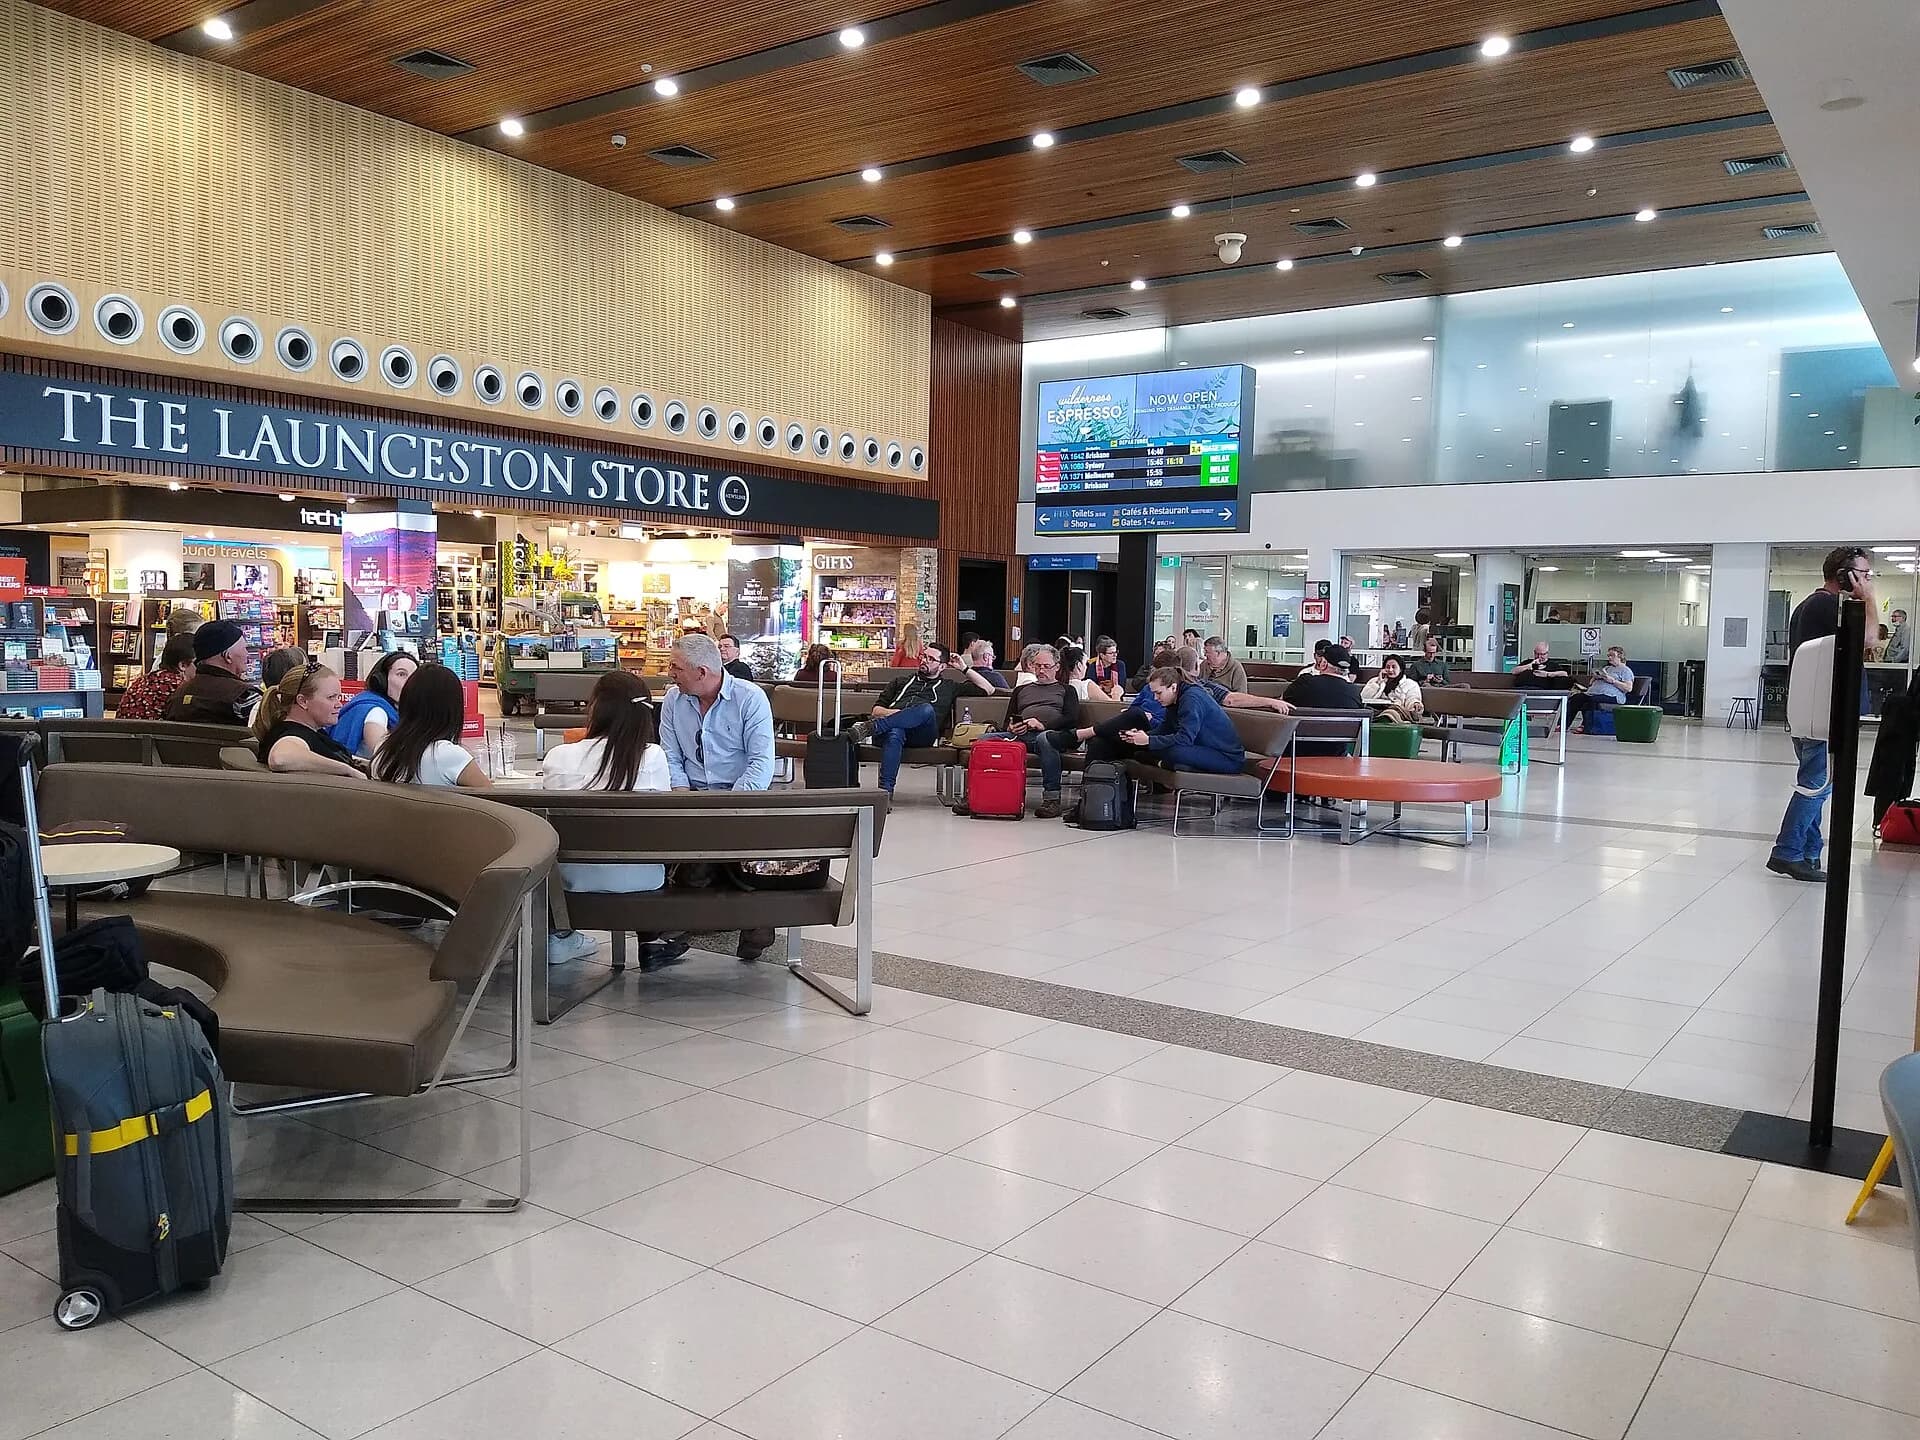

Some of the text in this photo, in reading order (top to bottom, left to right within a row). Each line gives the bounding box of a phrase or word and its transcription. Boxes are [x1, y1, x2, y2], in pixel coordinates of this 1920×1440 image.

[1057, 384, 1113, 406] wilderness
[1149, 390, 1218, 406] NOW OPEN
[1047, 406, 1122, 425] ESPRESSO
[43, 386, 710, 511] THE LAUNCESTON STORE
[1060, 453, 1069, 461] VA
[1085, 451, 1110, 459] Brisbane
[1146, 447, 1164, 455] 14:40
[1060, 463, 1069, 471] VA
[1085, 461, 1105, 471] Sydney
[1146, 458, 1164, 466] 15:45
[1209, 455, 1230, 463] RELAX
[1084, 471, 1115, 480] Melbourne
[1209, 465, 1230, 473] RELAX
[1084, 481, 1109, 490] Brisbane
[1208, 475, 1230, 484] RELAX
[1071, 509, 1095, 518] Toilets
[1121, 506, 1142, 516] Cafés
[1142, 507, 1149, 515] &
[1149, 505, 1190, 515] Restaurant
[1070, 519, 1088, 529] Shop
[1121, 517, 1142, 527] Gates
[1143, 517, 1156, 526] 1-4
[183, 545, 268, 560] ound travels
[813, 554, 854, 570] GIFTS
[924, 555, 932, 594] HEART
[737, 593, 769, 601] Launceston
[743, 587, 764, 596] Best of
[923, 600, 931, 614] OF
